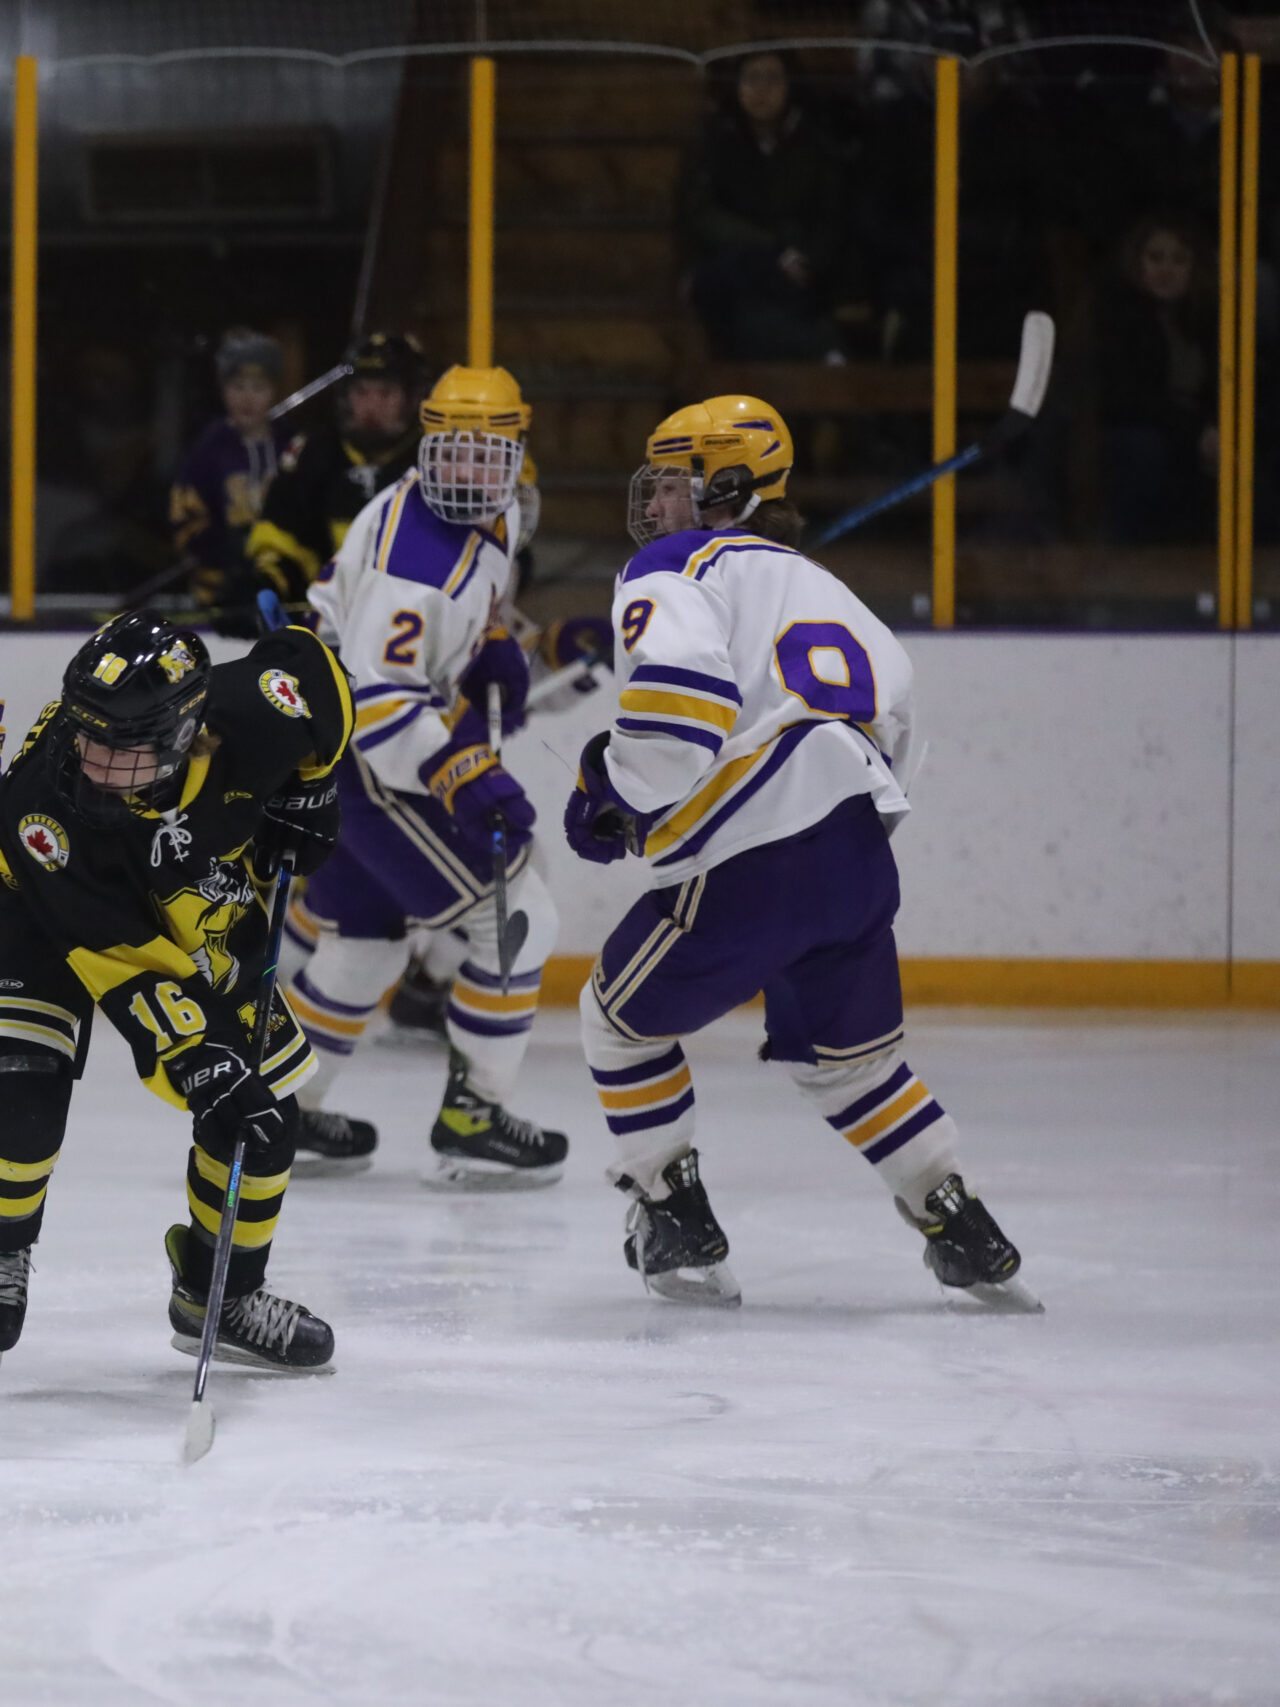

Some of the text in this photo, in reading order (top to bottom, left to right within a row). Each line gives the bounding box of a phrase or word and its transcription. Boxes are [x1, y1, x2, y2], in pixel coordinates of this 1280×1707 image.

[384, 610, 424, 667] 2
[621, 600, 655, 654] 9
[92, 652, 128, 685] 16
[128, 981, 208, 1053] 16
